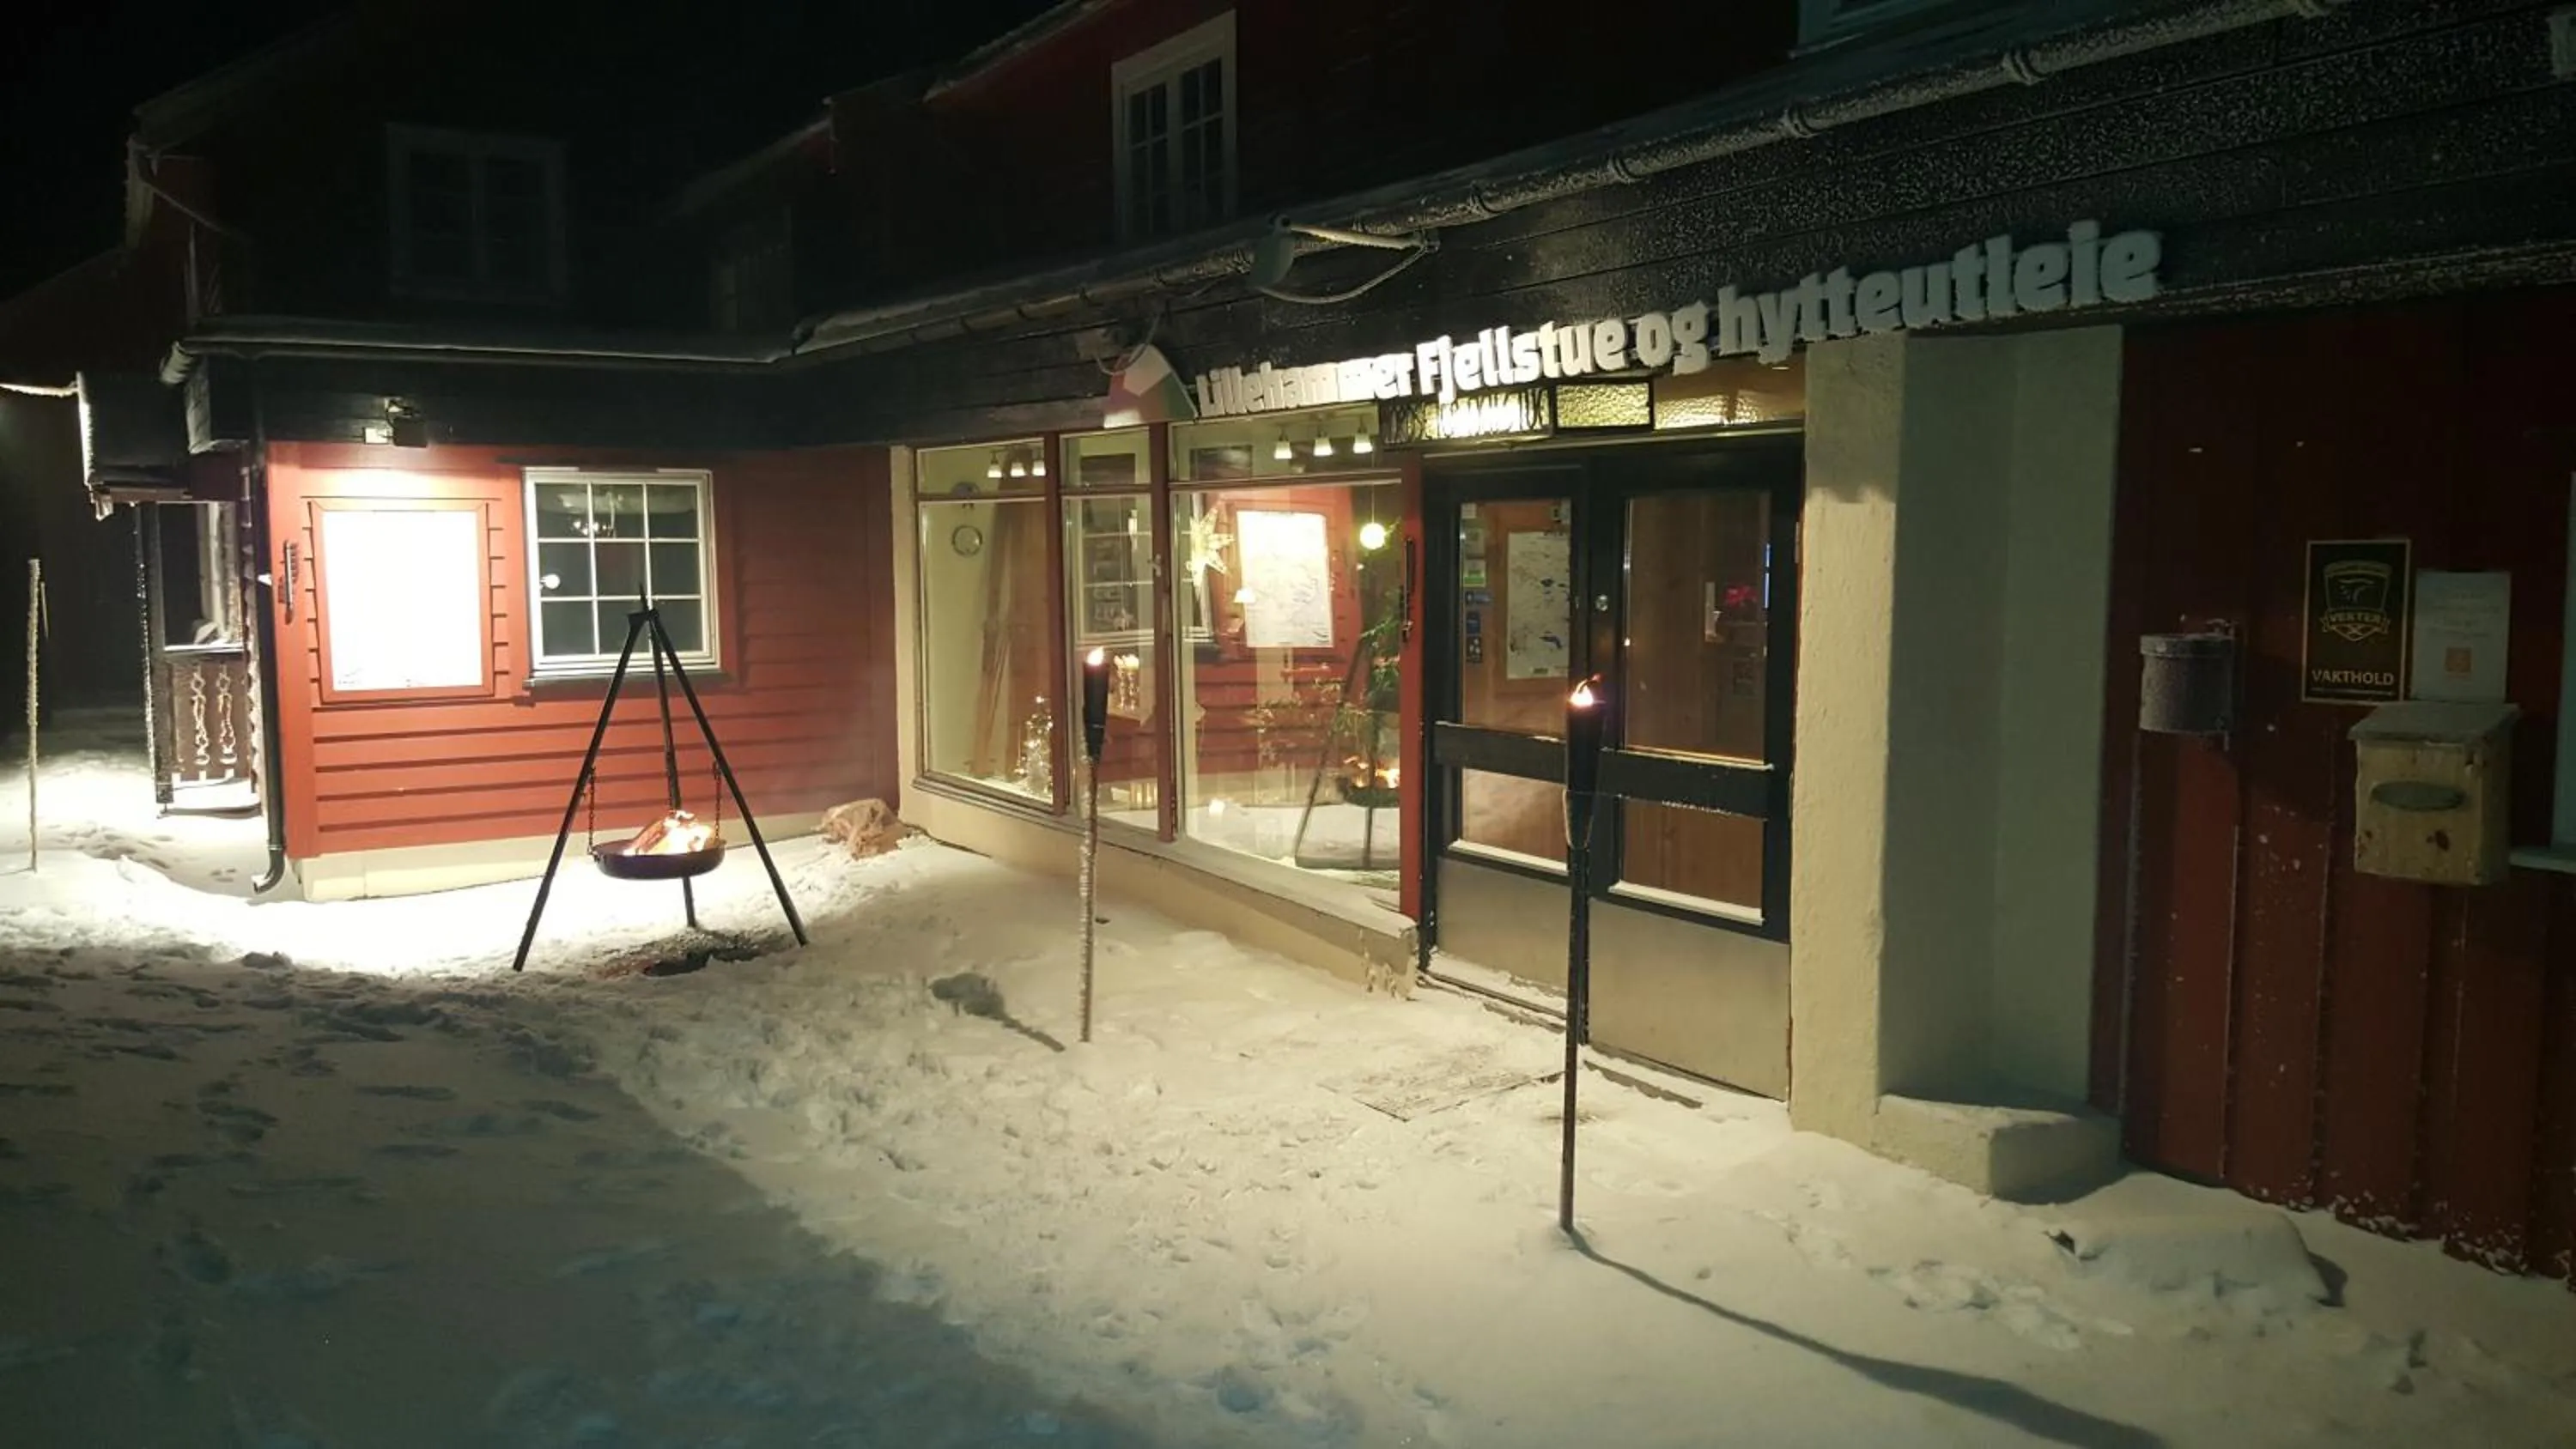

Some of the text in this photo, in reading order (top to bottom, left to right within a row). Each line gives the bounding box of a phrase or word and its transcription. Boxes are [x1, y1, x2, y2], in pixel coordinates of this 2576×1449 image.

[1196, 220, 2162, 418] Lillehammer Fjellstue og hytteutleie
[2312, 669, 2395, 686] VAKTHOLD
